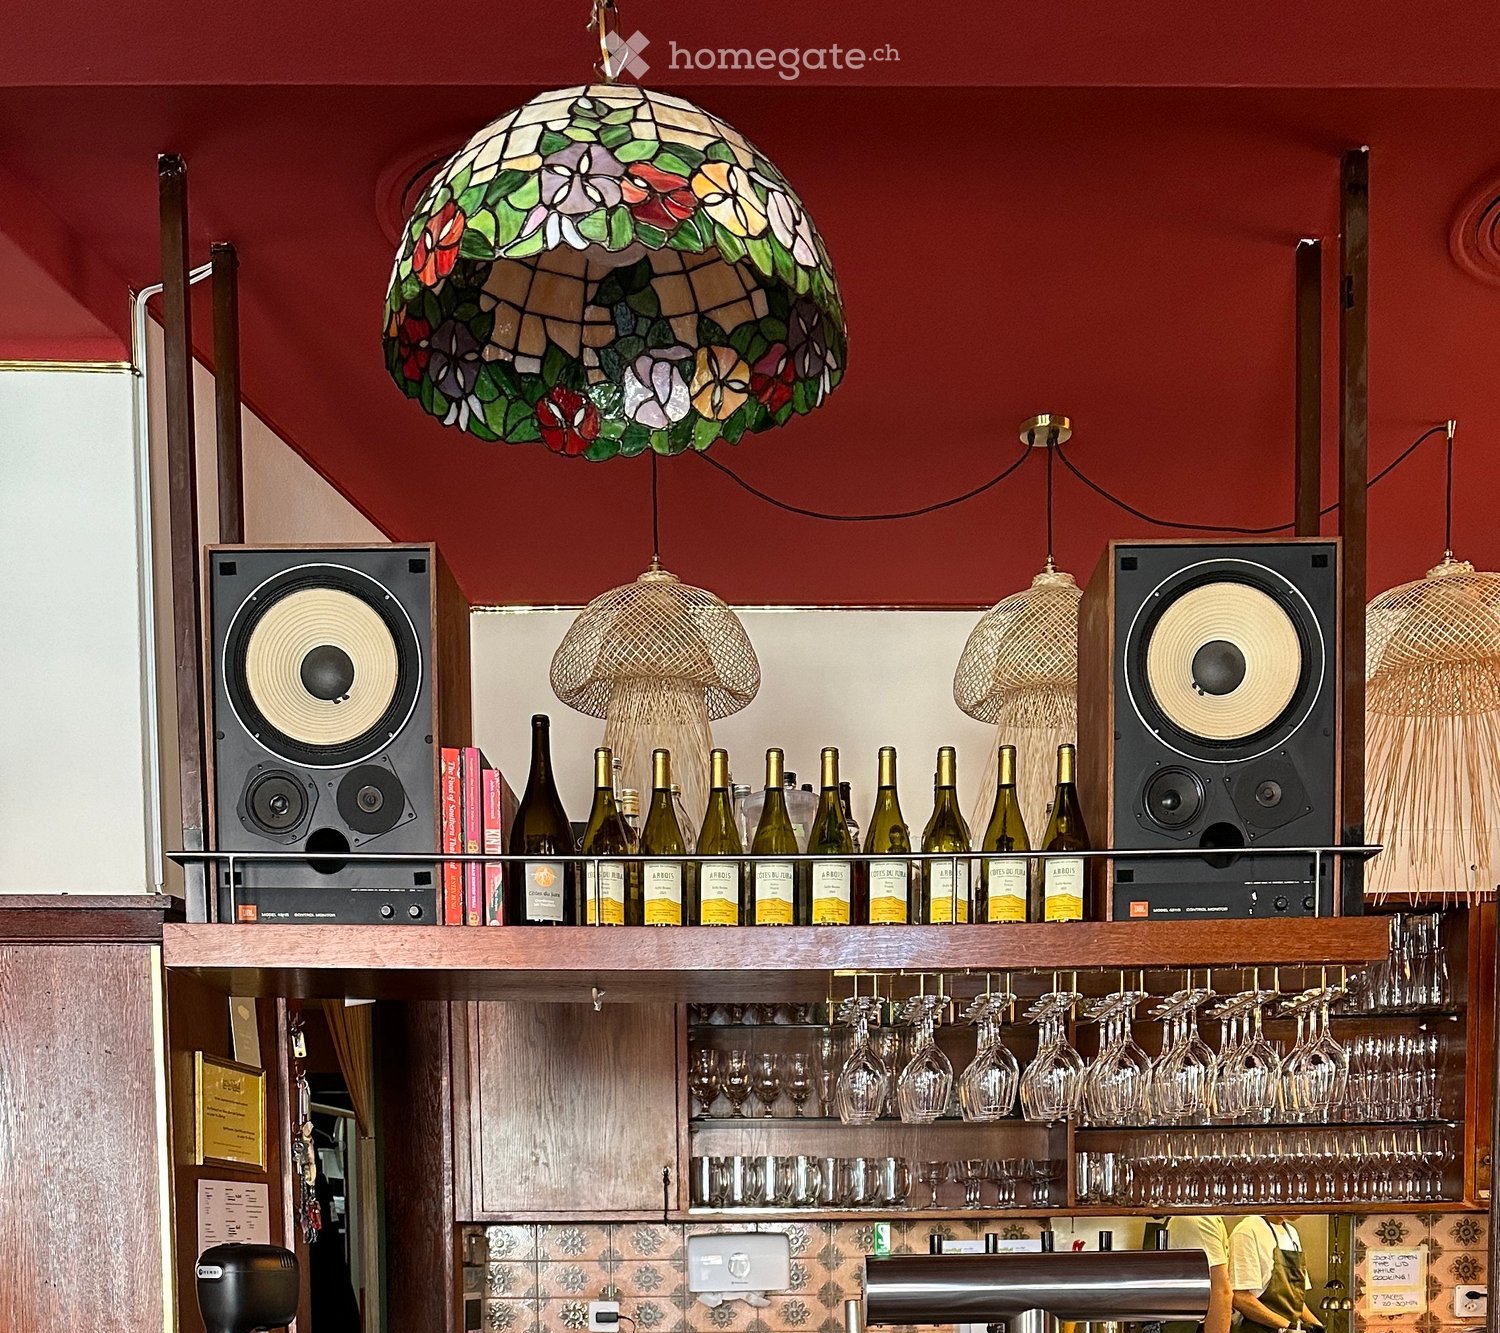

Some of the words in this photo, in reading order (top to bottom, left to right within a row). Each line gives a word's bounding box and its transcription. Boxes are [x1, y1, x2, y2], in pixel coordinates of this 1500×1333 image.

[447, 761, 456, 776] The
[448, 776, 456, 794] Food
[448, 804, 456, 836] Southern
